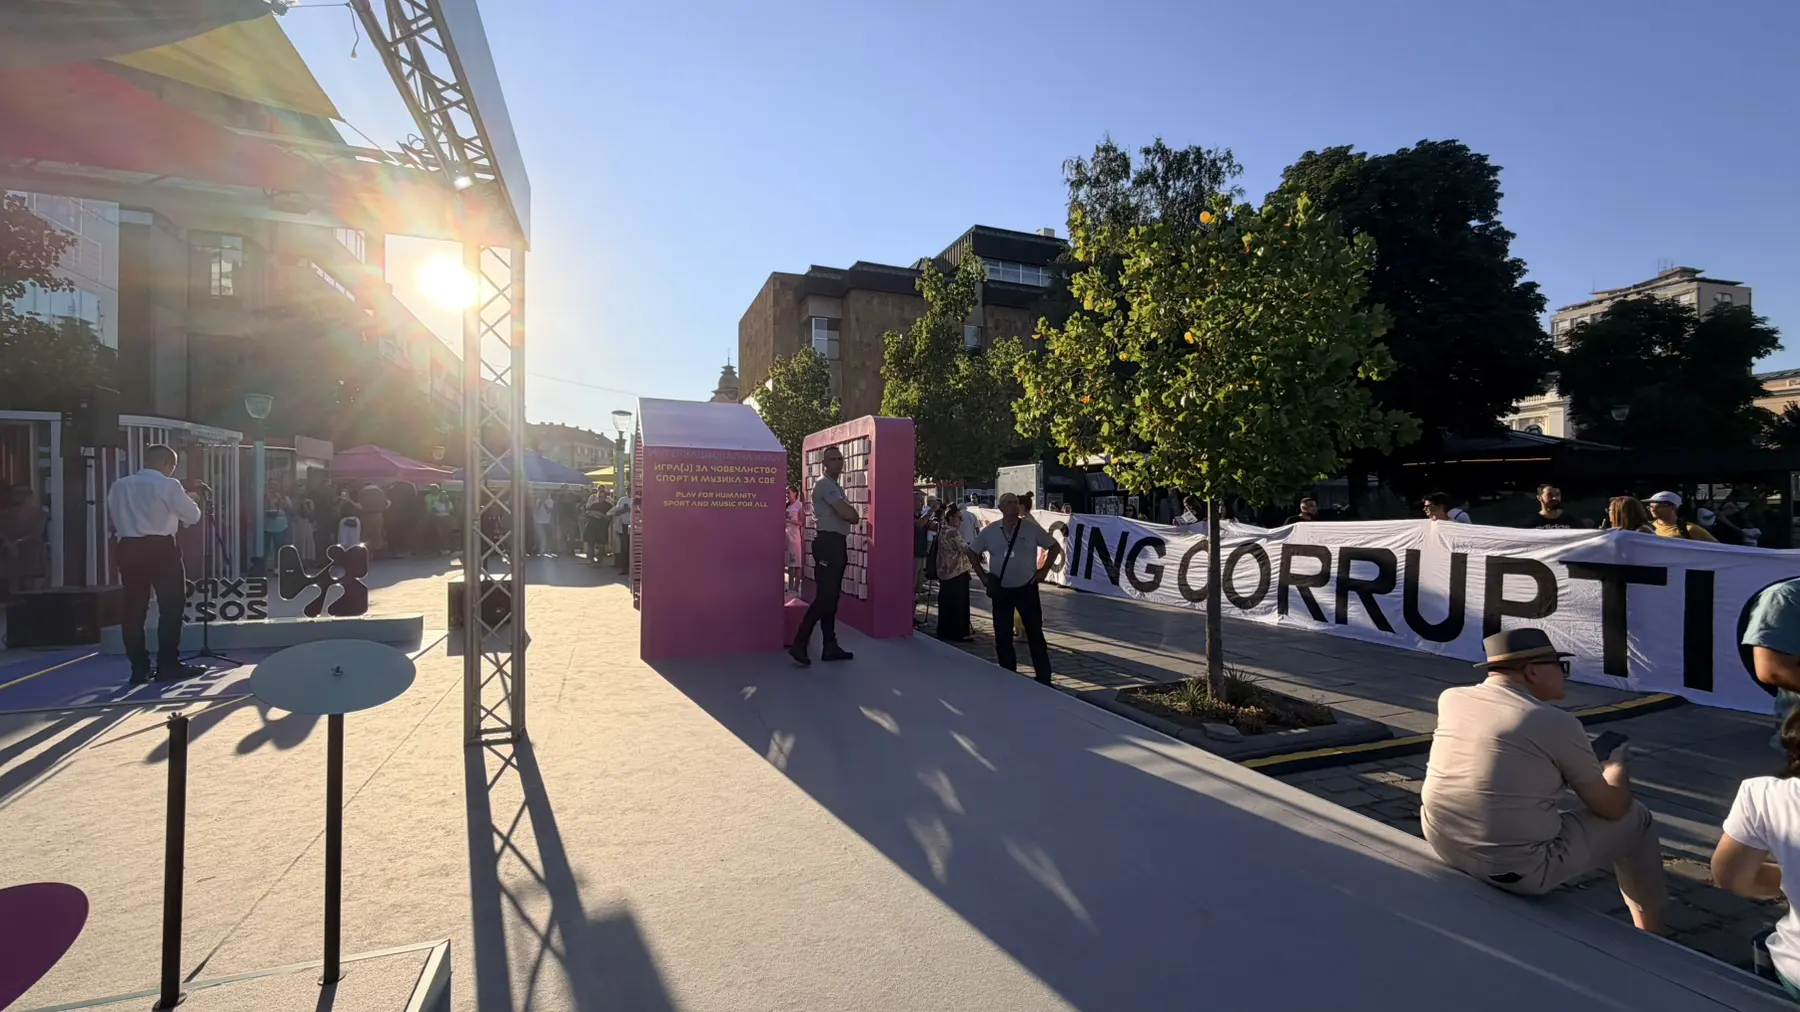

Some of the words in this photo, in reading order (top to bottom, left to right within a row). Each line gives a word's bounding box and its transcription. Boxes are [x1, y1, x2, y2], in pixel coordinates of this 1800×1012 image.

[695, 464, 708, 472] ЗА
[710, 465, 778, 474] ЧОВЕЧАНСТВО
[655, 474, 689, 483] СПОРТ
[690, 475, 698, 483] И
[700, 476, 742, 484] МУЗИКА
[743, 476, 756, 484] ЗА
[1178, 539, 1800, 698] CORRUPTI
